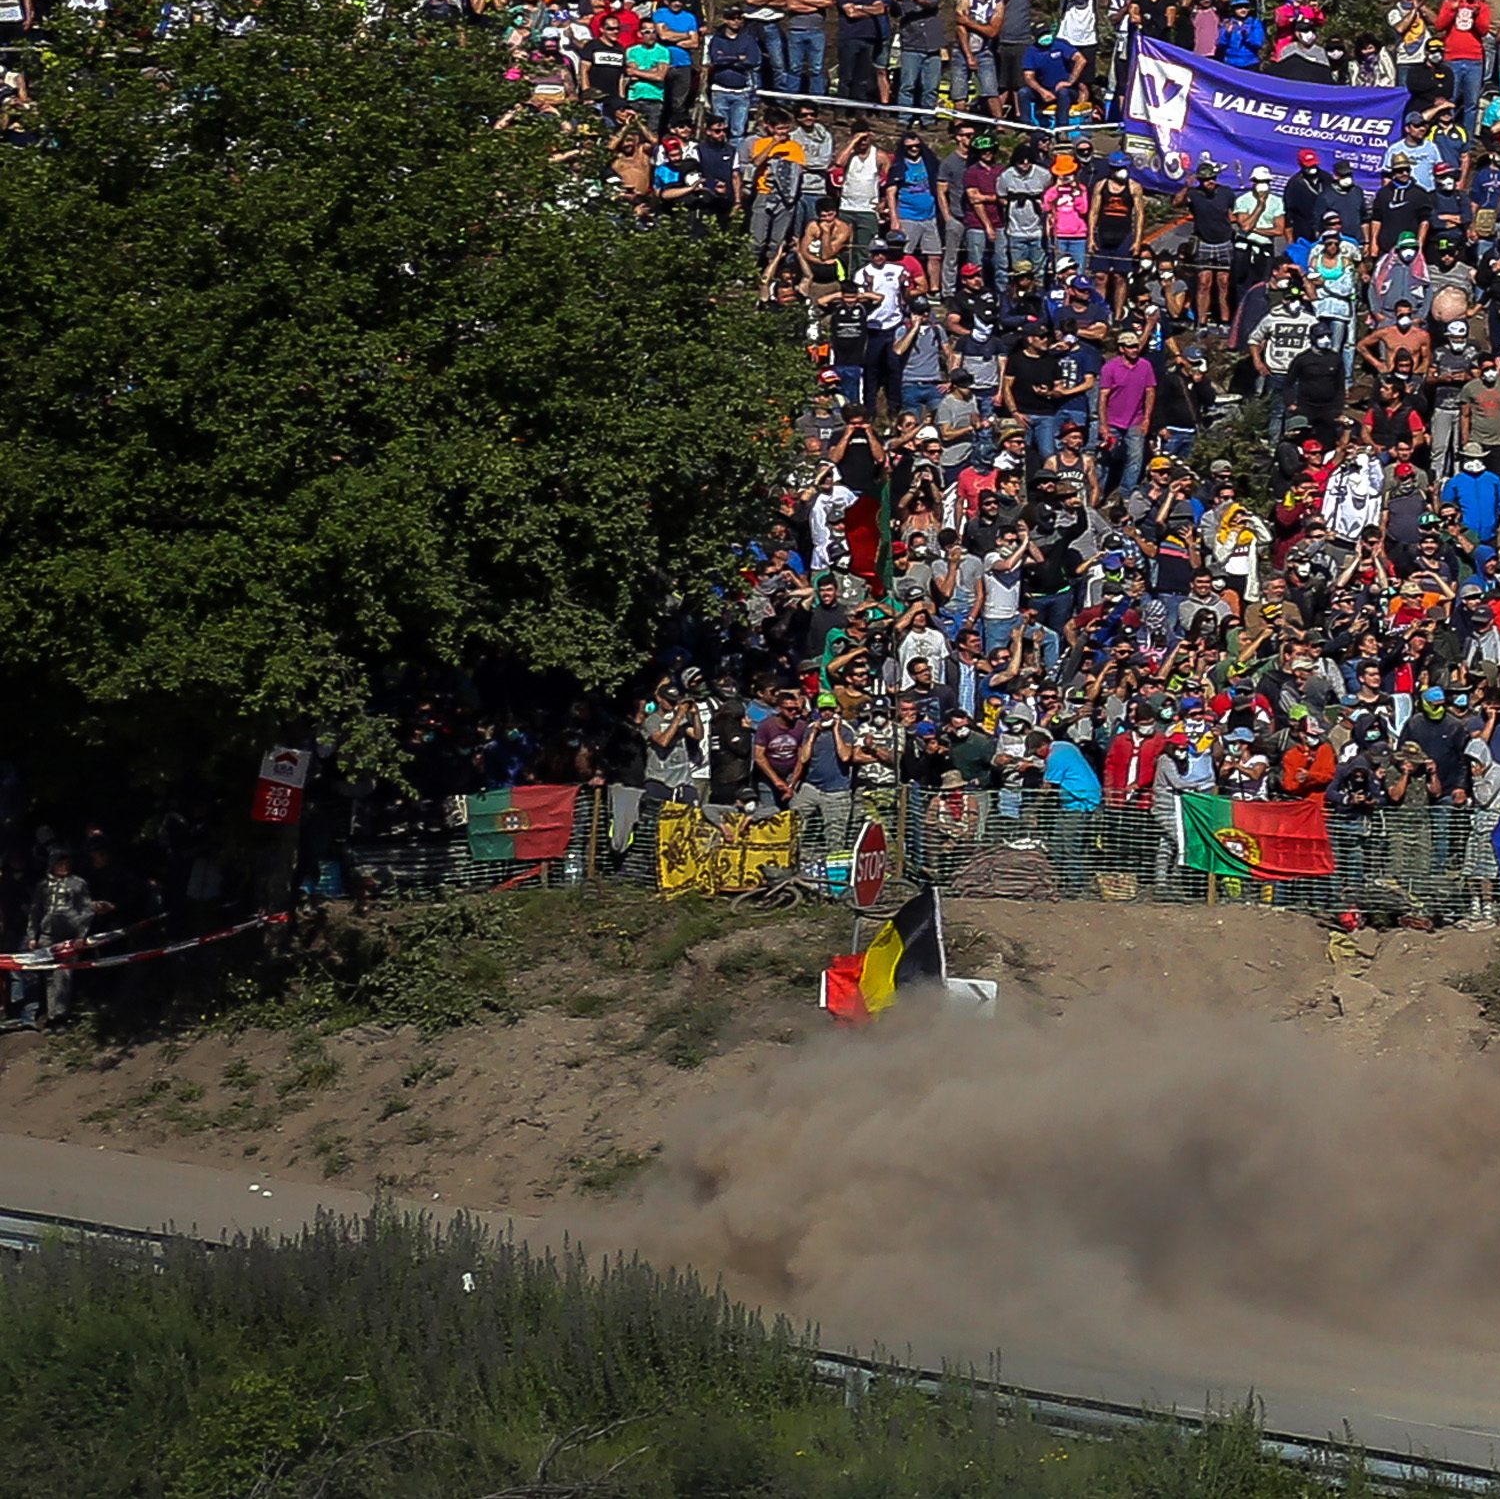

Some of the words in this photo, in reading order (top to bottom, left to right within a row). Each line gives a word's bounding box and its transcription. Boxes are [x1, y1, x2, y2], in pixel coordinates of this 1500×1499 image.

[1213, 91, 1287, 122] VALES
[1292, 108, 1313, 126] &
[1319, 113, 1393, 136] VALES
[1368, 138, 1389, 148] LDA
[266, 796, 290, 807] 700
[265, 806, 288, 817] 740
[856, 850, 887, 882] STOP
